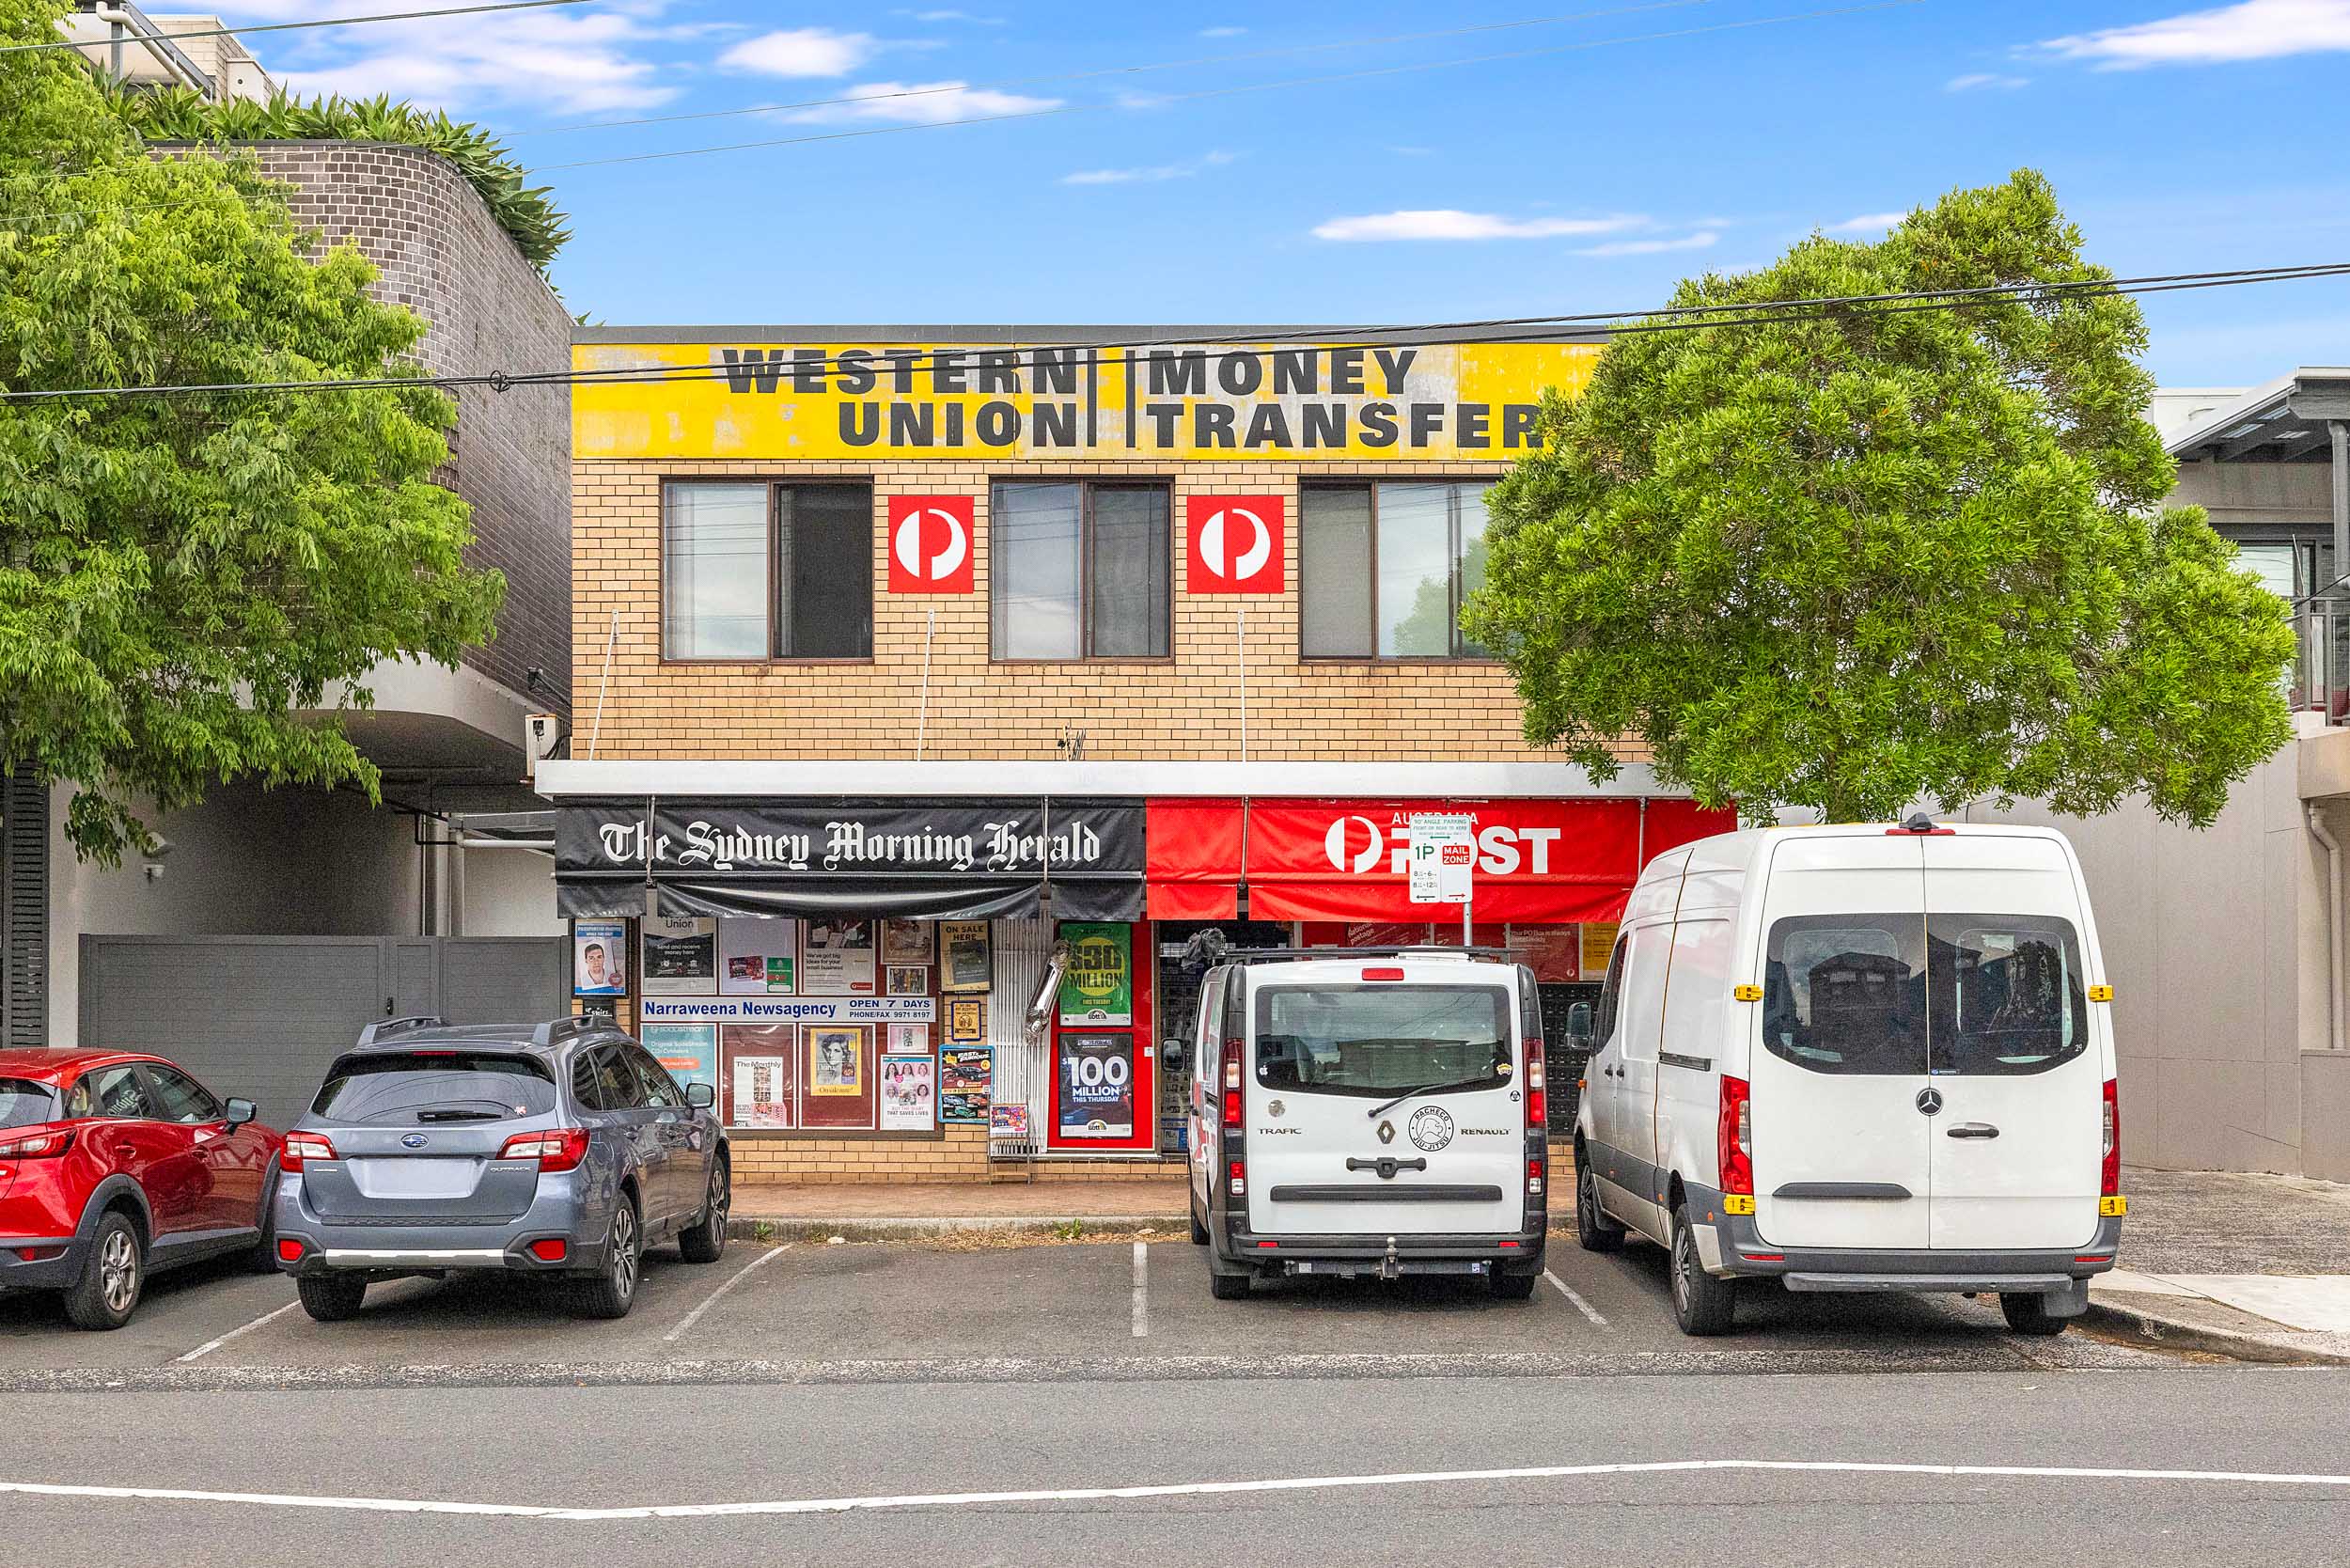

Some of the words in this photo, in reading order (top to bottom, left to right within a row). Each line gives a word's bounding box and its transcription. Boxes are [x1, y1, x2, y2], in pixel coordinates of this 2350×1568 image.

[722, 349, 1076, 394] WESTERN
[1149, 349, 1417, 396] MONEY
[838, 401, 1076, 447] UNION
[1146, 402, 1544, 448] TRANSFER
[599, 820, 671, 862] The
[678, 820, 810, 870] Sydney
[822, 821, 975, 871] Morning
[983, 820, 1100, 872] Herald
[1415, 845, 1434, 860] 1P
[1444, 846, 1468, 855] MAIL
[1443, 855, 1469, 864] ZONE
[666, 918, 694, 929] Union
[1070, 972, 1122, 988] MILLION
[645, 1001, 737, 1015] Narraweena
[743, 1001, 837, 1018] Newsagency
[850, 999, 880, 1008] OPEN
[886, 999, 897, 1008] 7
[903, 999, 931, 1008] DAYS
[751, 1060, 781, 1069] Monthly
[1072, 1086, 1120, 1096] MILLION
[1415, 1107, 1449, 1122] PACHECO
[1413, 1136, 1449, 1150] JIU-JITSU
